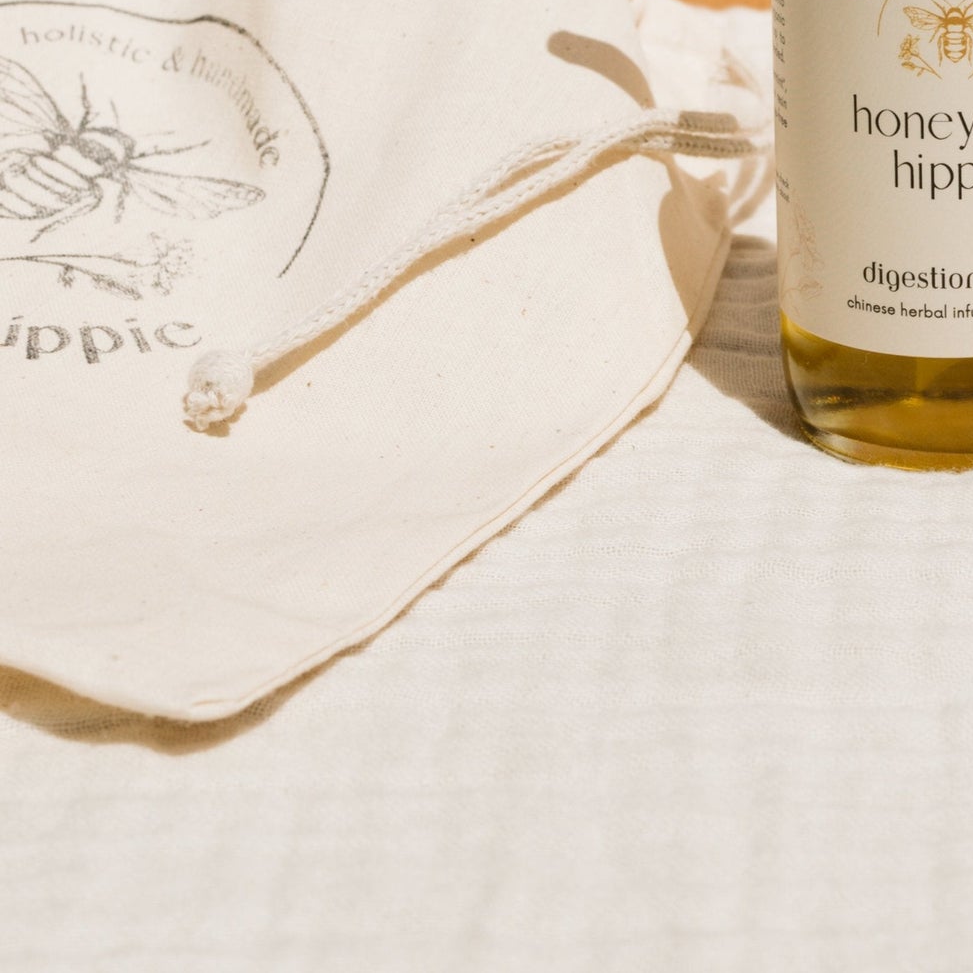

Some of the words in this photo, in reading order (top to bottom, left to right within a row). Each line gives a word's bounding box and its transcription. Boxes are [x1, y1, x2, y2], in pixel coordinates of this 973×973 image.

[20, 25, 152, 63] holistic
[160, 45, 184, 74] &
[846, 294, 896, 317] chinese
[899, 300, 948, 319] herbal
